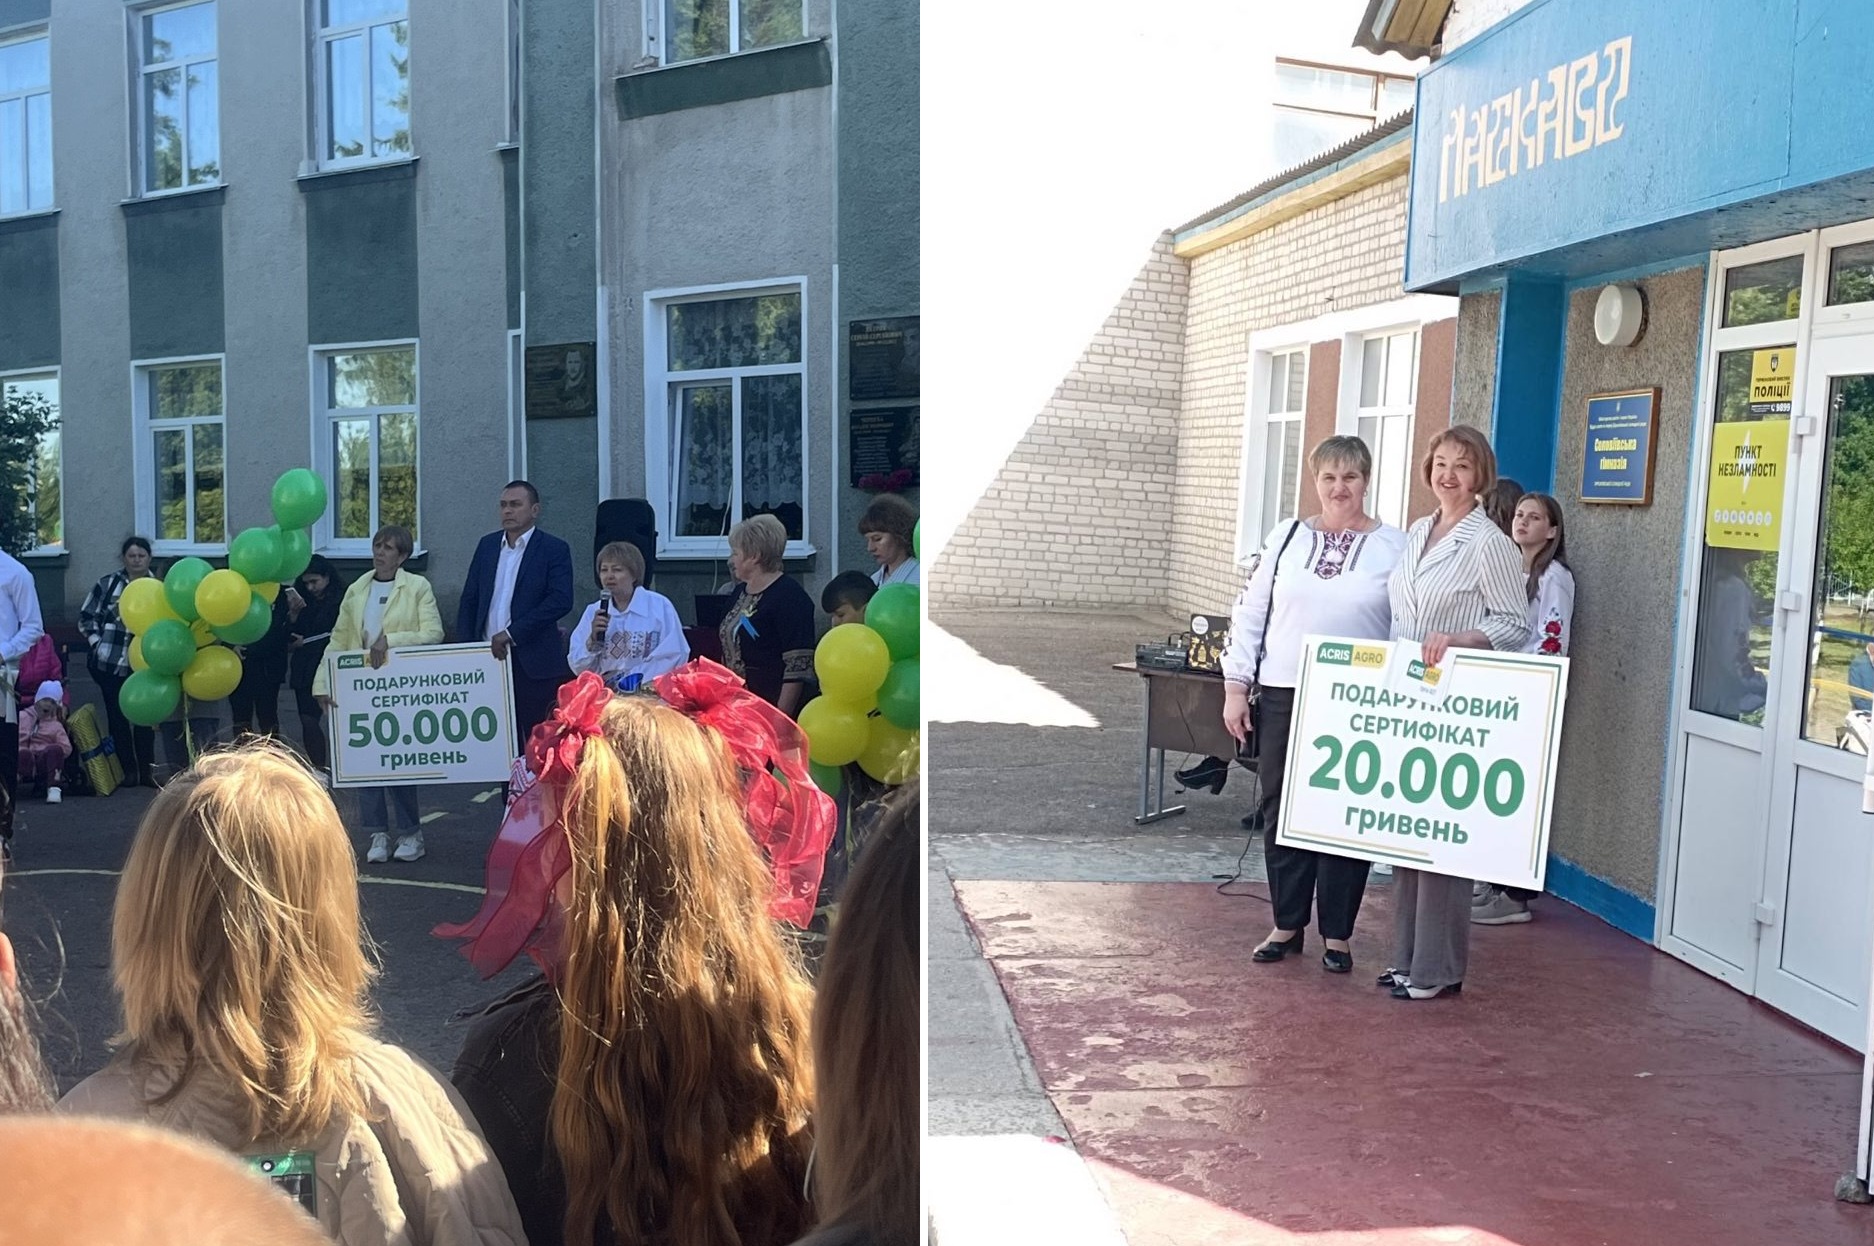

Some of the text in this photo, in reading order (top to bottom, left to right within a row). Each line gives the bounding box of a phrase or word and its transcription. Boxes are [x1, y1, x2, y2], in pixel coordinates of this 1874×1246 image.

[1754, 382, 1791, 398] ПОЛІЦІЇ
[1734, 445, 1762, 459] ПУНКТ
[1718, 463, 1776, 477] НЕЗЛАМНОСТІ
[340, 658, 363, 666] ACRIS
[1319, 647, 1383, 664] ACRIS AGRO
[353, 669, 485, 692] ПОДАРУНКОВИЙ
[371, 691, 469, 708] СЕРТИФІКАТ
[348, 706, 498, 748] 50.000
[1349, 713, 1490, 748] СЕРТИФІКАТ
[380, 750, 467, 770] гривень
[1308, 734, 1525, 817] 20.000
[1345, 806, 1468, 844] гривень
